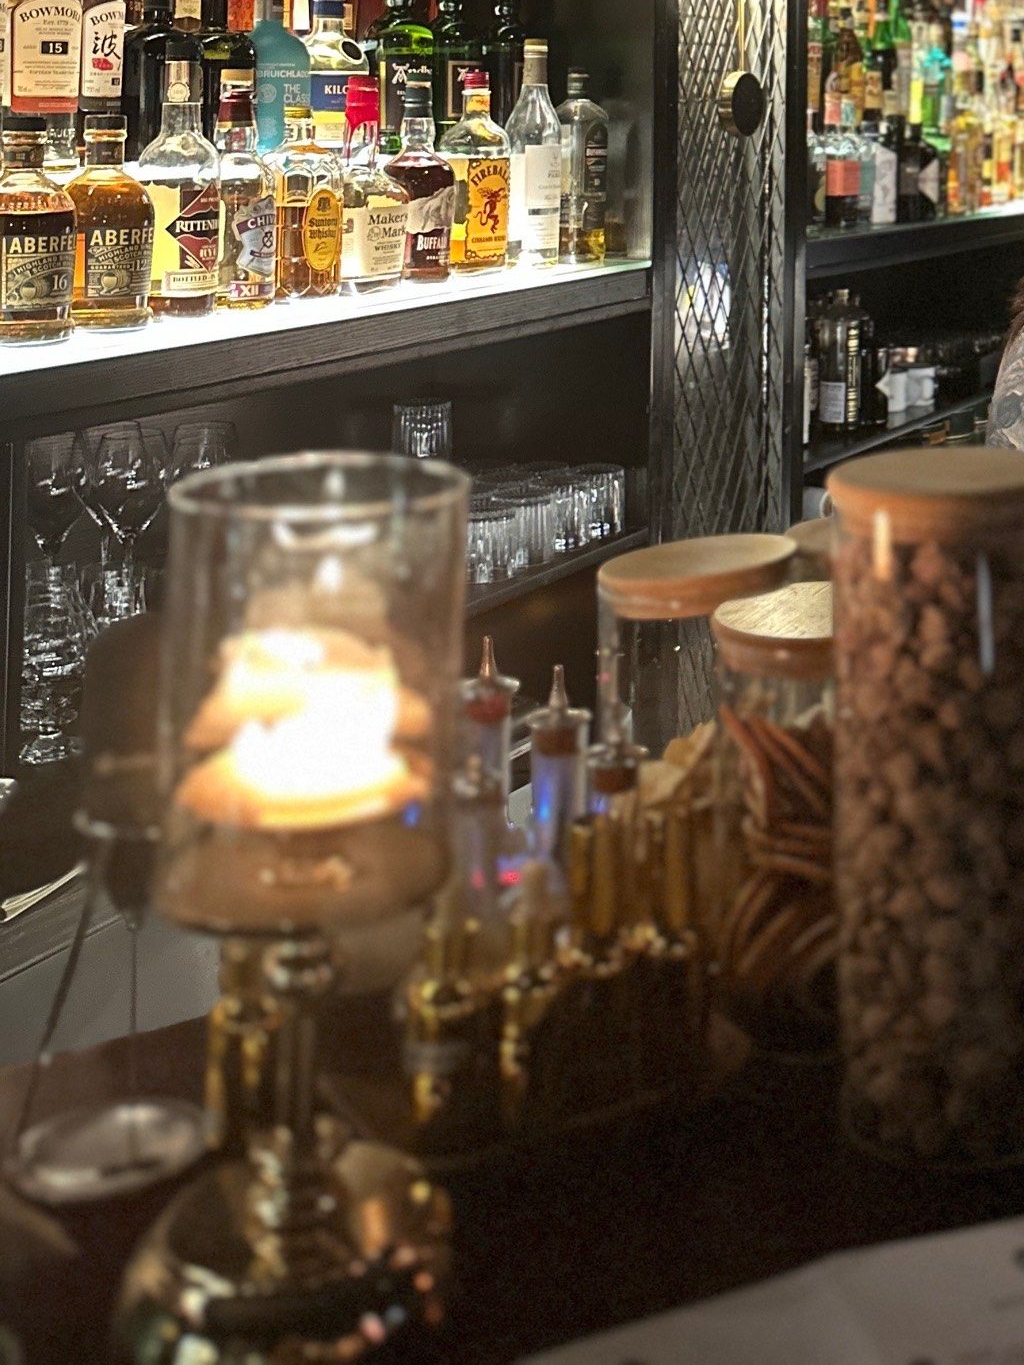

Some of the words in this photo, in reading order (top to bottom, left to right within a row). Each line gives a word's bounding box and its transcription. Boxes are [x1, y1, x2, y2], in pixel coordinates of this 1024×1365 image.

[49, 42, 63, 53] 15
[284, 83, 301, 94] THE
[309, 217, 338, 228] Suntory
[381, 226, 406, 238] Mark
[136, 258, 148, 271] 12
[52, 273, 68, 292] 16
